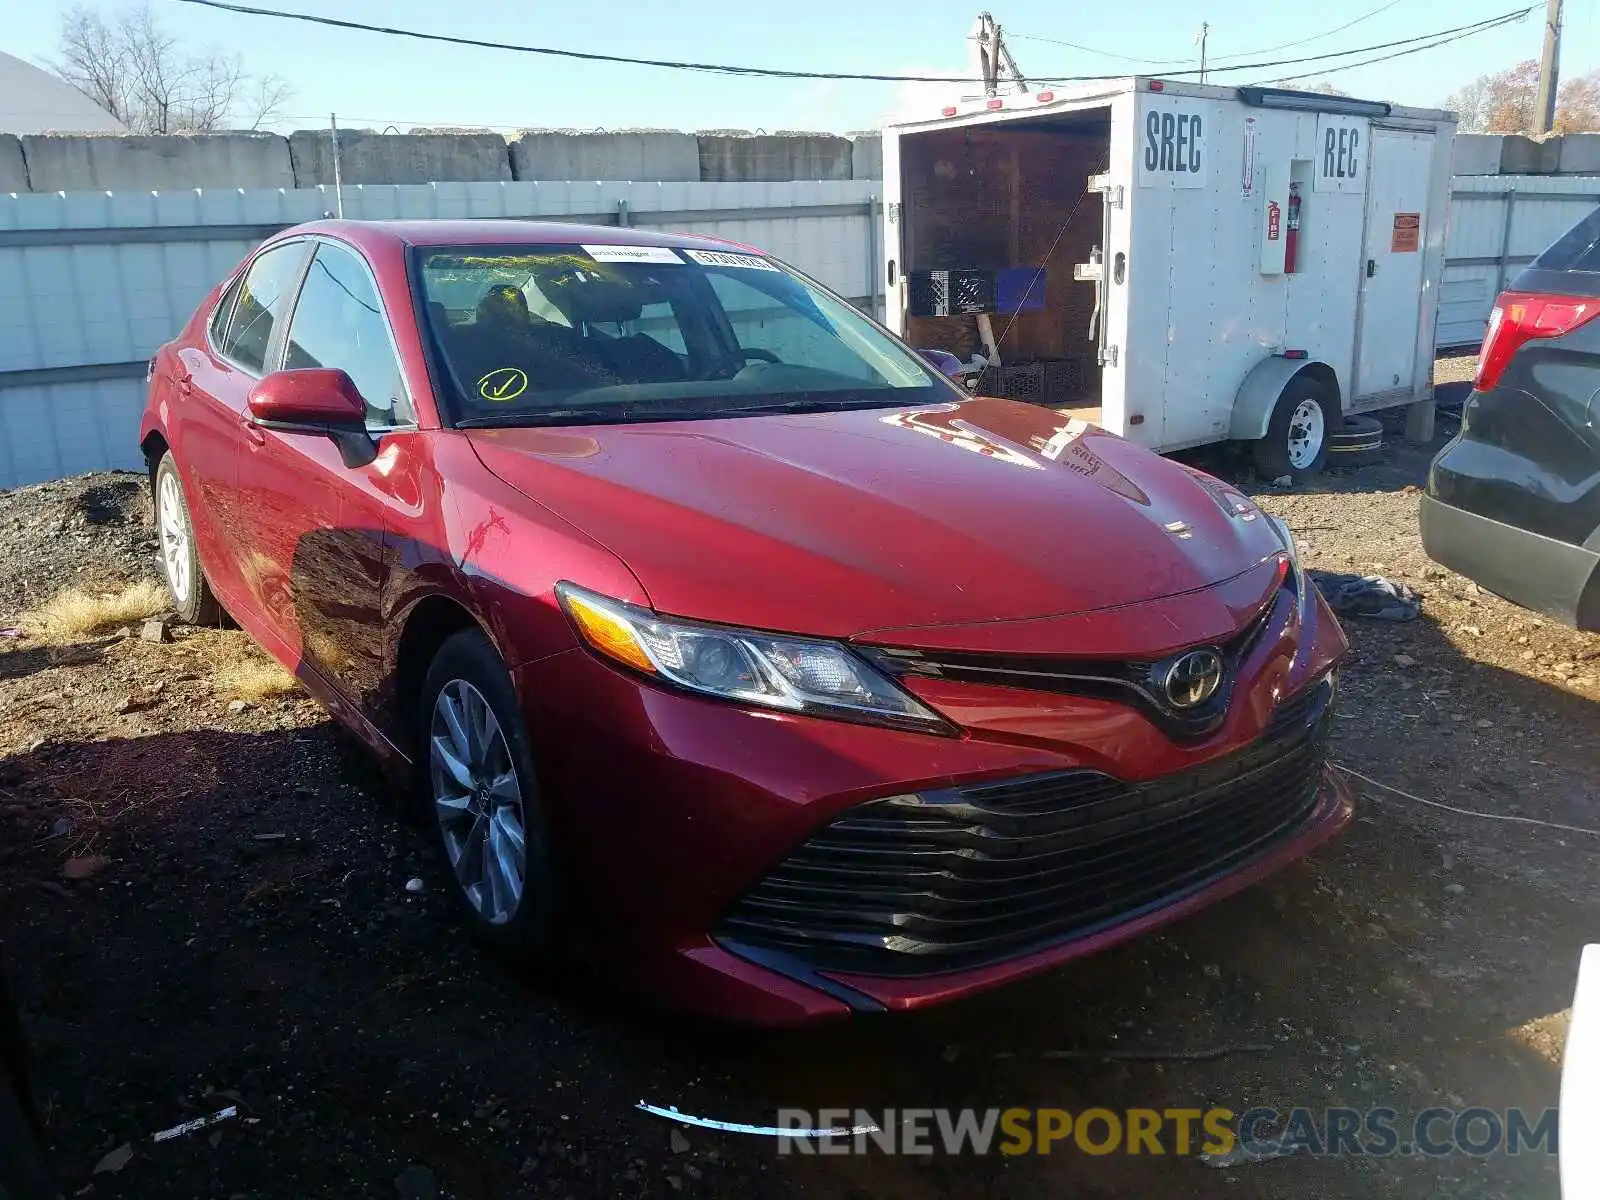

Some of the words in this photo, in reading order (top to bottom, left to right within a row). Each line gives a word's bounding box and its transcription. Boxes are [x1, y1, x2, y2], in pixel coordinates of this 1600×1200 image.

[1145, 110, 1202, 173] SREC
[1323, 127, 1359, 178] REC
[1270, 210, 1280, 239] FIRE
